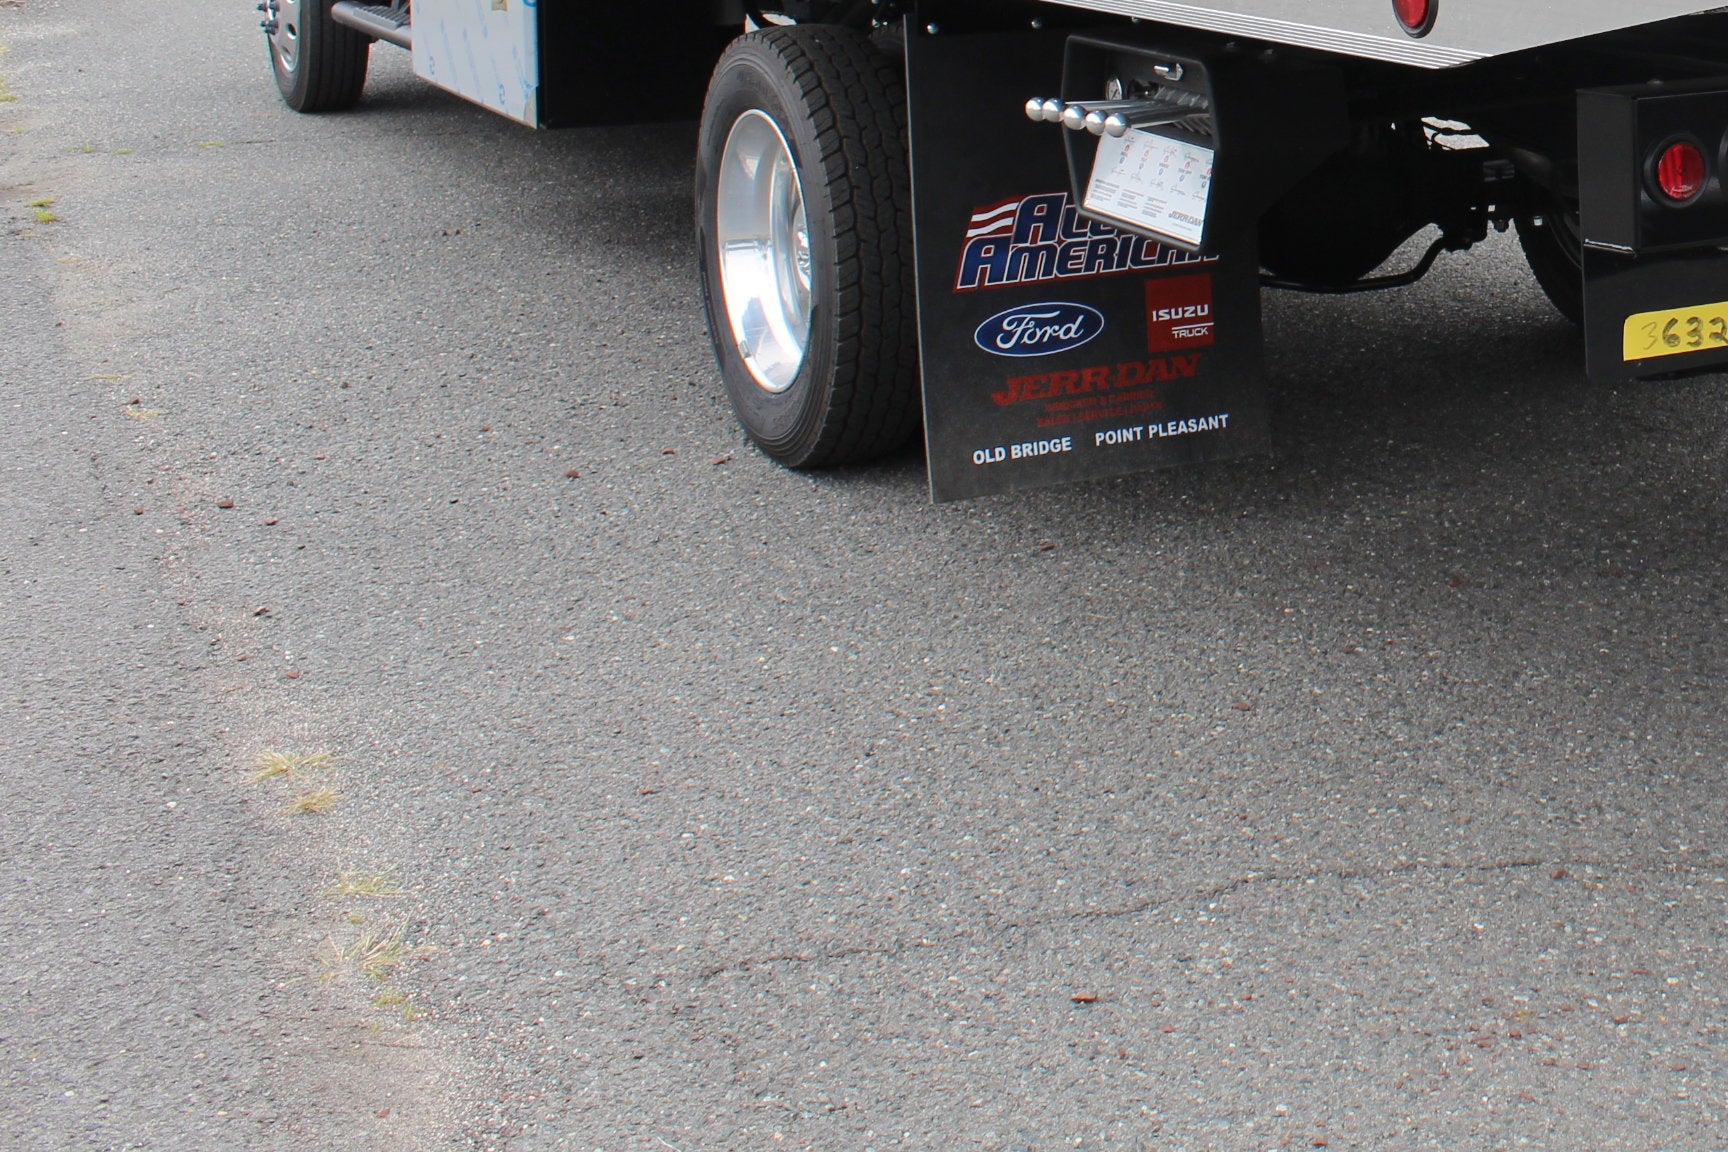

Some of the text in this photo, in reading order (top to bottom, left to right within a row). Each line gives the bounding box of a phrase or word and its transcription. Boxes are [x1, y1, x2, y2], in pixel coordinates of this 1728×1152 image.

[957, 234, 1220, 289] AMERIC
[997, 311, 1084, 349] Ford
[1152, 304, 1209, 322] ISUZU
[1172, 327, 1209, 339] TRUCK
[991, 353, 1203, 407] JERR-DAN
[972, 414, 1229, 465] OLD BRIDGE POINT PLEASANT
